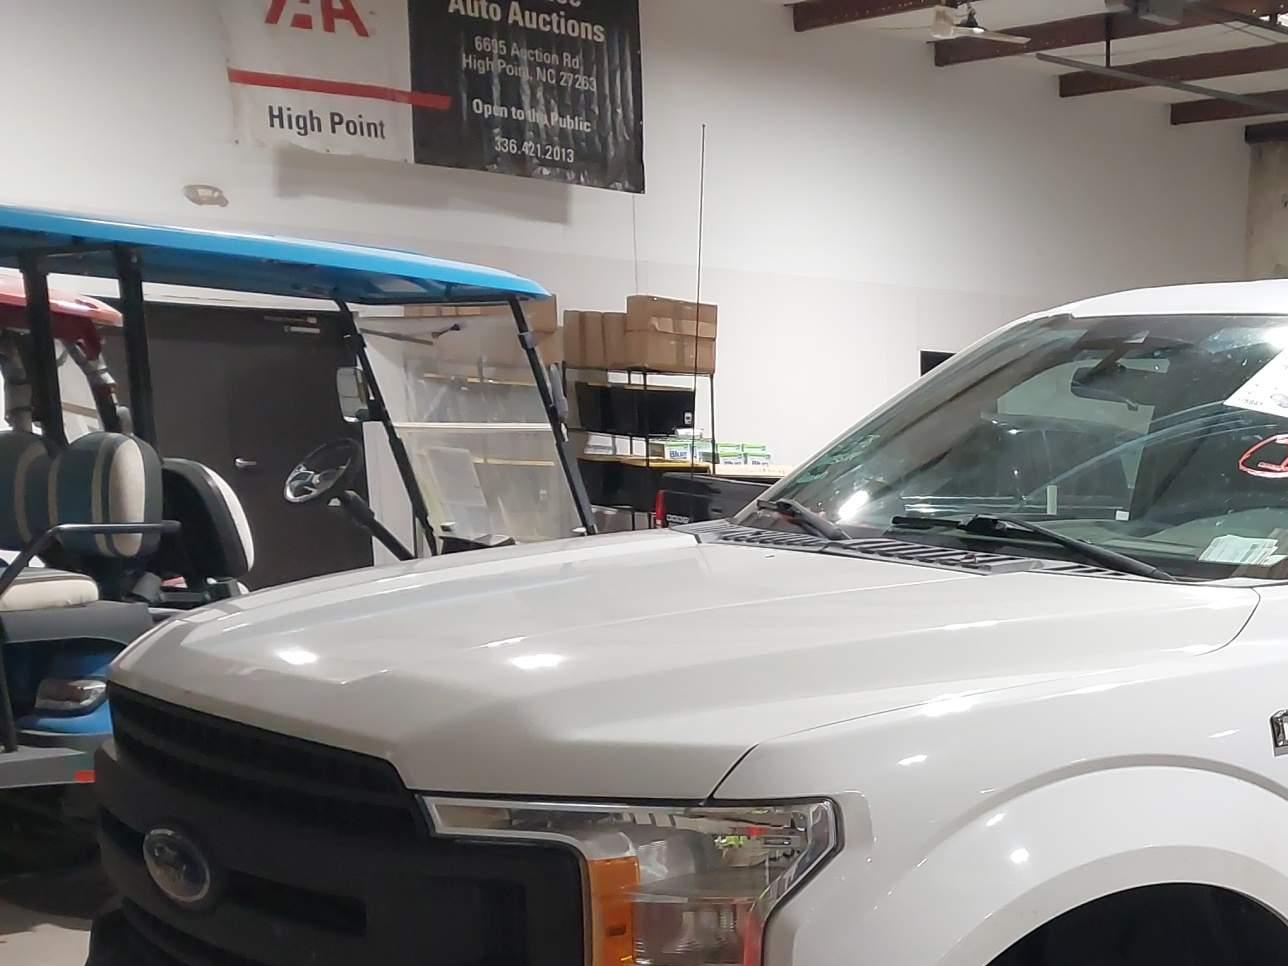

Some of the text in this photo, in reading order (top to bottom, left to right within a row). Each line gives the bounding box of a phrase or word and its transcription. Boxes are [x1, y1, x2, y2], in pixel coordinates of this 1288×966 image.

[448, 0, 606, 43] Auto Auctions
[462, 53, 495, 75] High
[536, 66, 556, 84] NC
[559, 71, 597, 92] 27263
[511, 43, 559, 66] Auction
[562, 52, 580, 70] Rd
[268, 105, 386, 140] High Point
[472, 98, 508, 118] Open
[511, 106, 524, 121] to
[550, 111, 592, 133] Public
[494, 136, 575, 164] 336.421.2013
